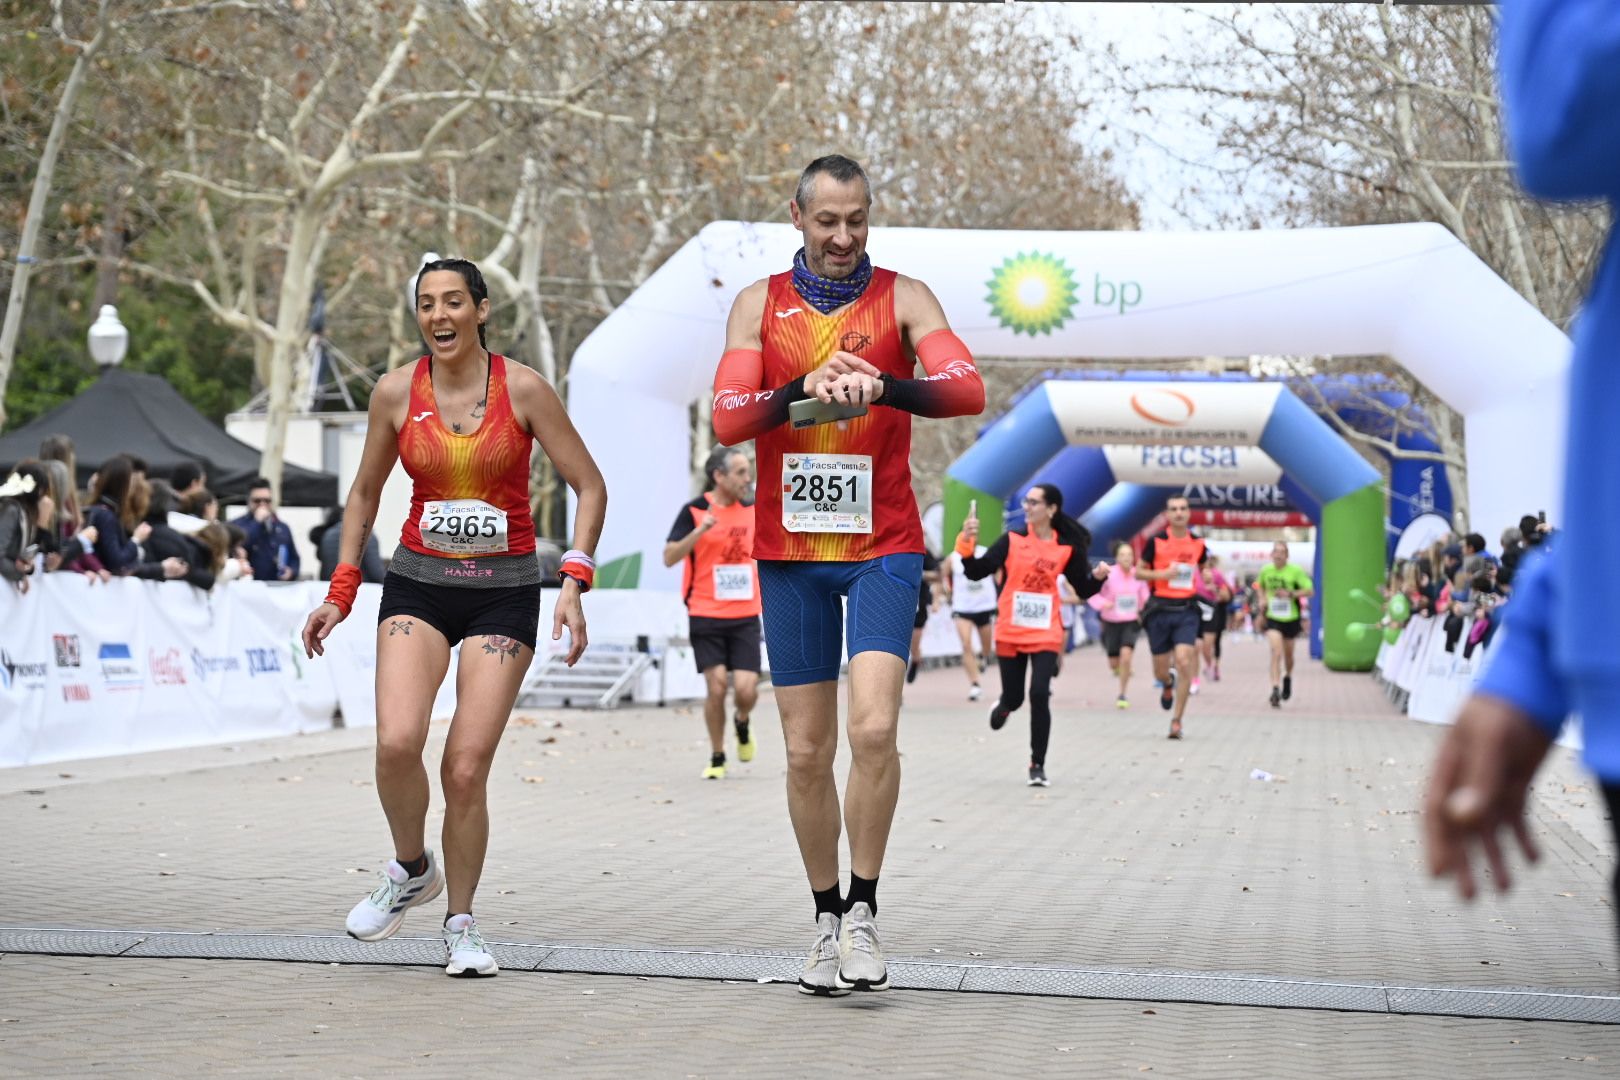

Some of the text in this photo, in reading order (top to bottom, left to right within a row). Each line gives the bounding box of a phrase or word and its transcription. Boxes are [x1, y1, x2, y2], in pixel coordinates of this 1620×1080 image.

[1093, 272, 1142, 315] bp
[791, 474, 857, 503] 2851
[814, 503, 837, 512] C&C
[428, 515, 498, 538] 2965
[451, 537, 474, 545] C&C
[444, 567, 493, 577] HANKER
